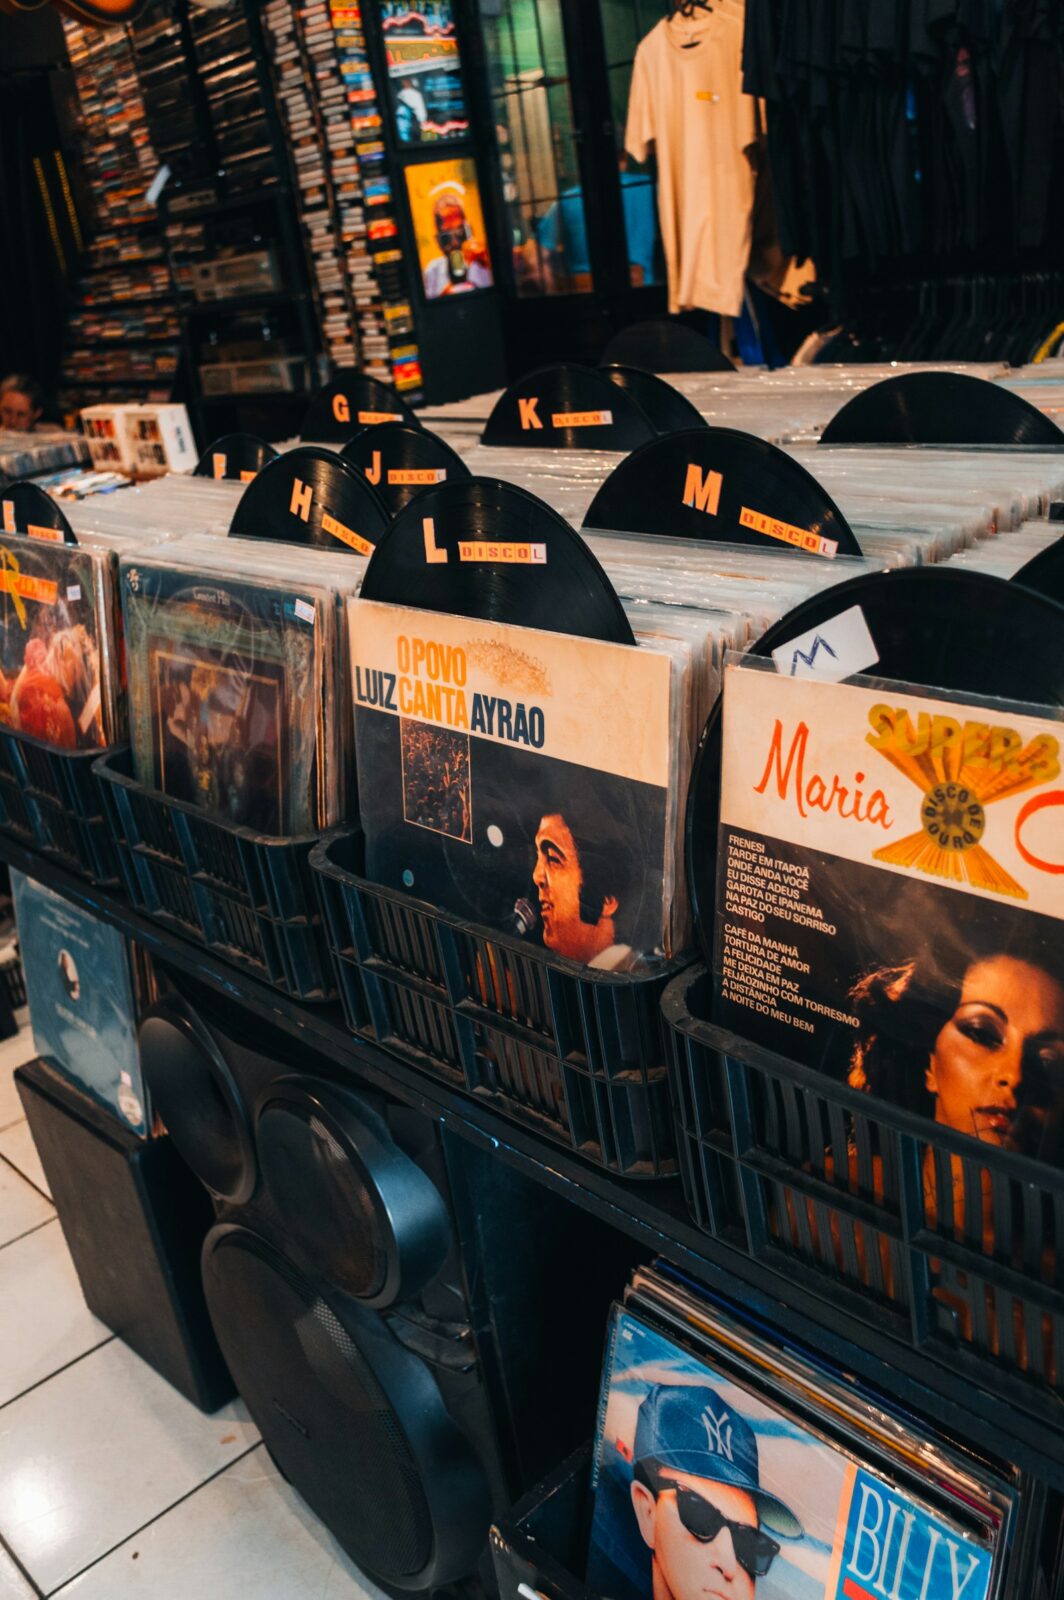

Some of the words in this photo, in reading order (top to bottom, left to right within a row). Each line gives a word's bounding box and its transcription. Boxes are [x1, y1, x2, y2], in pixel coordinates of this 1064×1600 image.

[332, 394, 350, 422] G
[518, 398, 543, 430] K
[365, 450, 381, 486] J
[289, 478, 313, 523] H
[682, 464, 723, 516] M
[423, 518, 448, 563] L
[355, 665, 398, 711] LUIZ
[398, 676, 470, 730] CANTA
[865, 703, 1023, 773] SUPER
[753, 719, 894, 830] Maria
[925, 786, 969, 817] DISCO
[967, 804, 982, 829] DE
[729, 834, 765, 853] FRENESI
[928, 823, 977, 848] OURO
[727, 857, 753, 873] ONDE
[753, 866, 782, 882] ANDA
[728, 845, 758, 863] TARDE
[759, 854, 773, 868] EM
[726, 879, 764, 900] GAROTA
[765, 891, 778, 905] DE
[779, 895, 824, 920] IPANEMA
[727, 868, 739, 880] EU
[740, 872, 766, 889] DISSE
[767, 881, 800, 900] ADEUS
[725, 901, 765, 923] CASTIGO
[726, 890, 740, 903] NA
[740, 895, 758, 909] PAZ
[758, 901, 773, 914] DO
[773, 906, 791, 920] SEU
[792, 912, 837, 936] SORRISO
[724, 923, 748, 939] CAFÉ
[748, 931, 761, 945] DA
[723, 945, 730, 955] A
[731, 947, 782, 975] FELICIDADE
[724, 933, 766, 958] TORTURA
[766, 949, 780, 962] DE
[780, 955, 811, 975] AMOR
[722, 977, 729, 988] A
[723, 956, 737, 969] ME
[738, 961, 765, 980] DEIXA
[765, 972, 780, 986] EM
[781, 978, 800, 993] PAZ
[721, 988, 728, 999] A
[729, 991, 755, 1010] NOITE
[755, 1002, 769, 1015] DO
[770, 1008, 791, 1024] MEU
[792, 1016, 815, 1034] BEM
[780, 989, 804, 1007] COM
[804, 998, 861, 1029] TORRESMO
[701, 1405, 734, 1462] NY
[846, 1482, 981, 1600] BILLY
